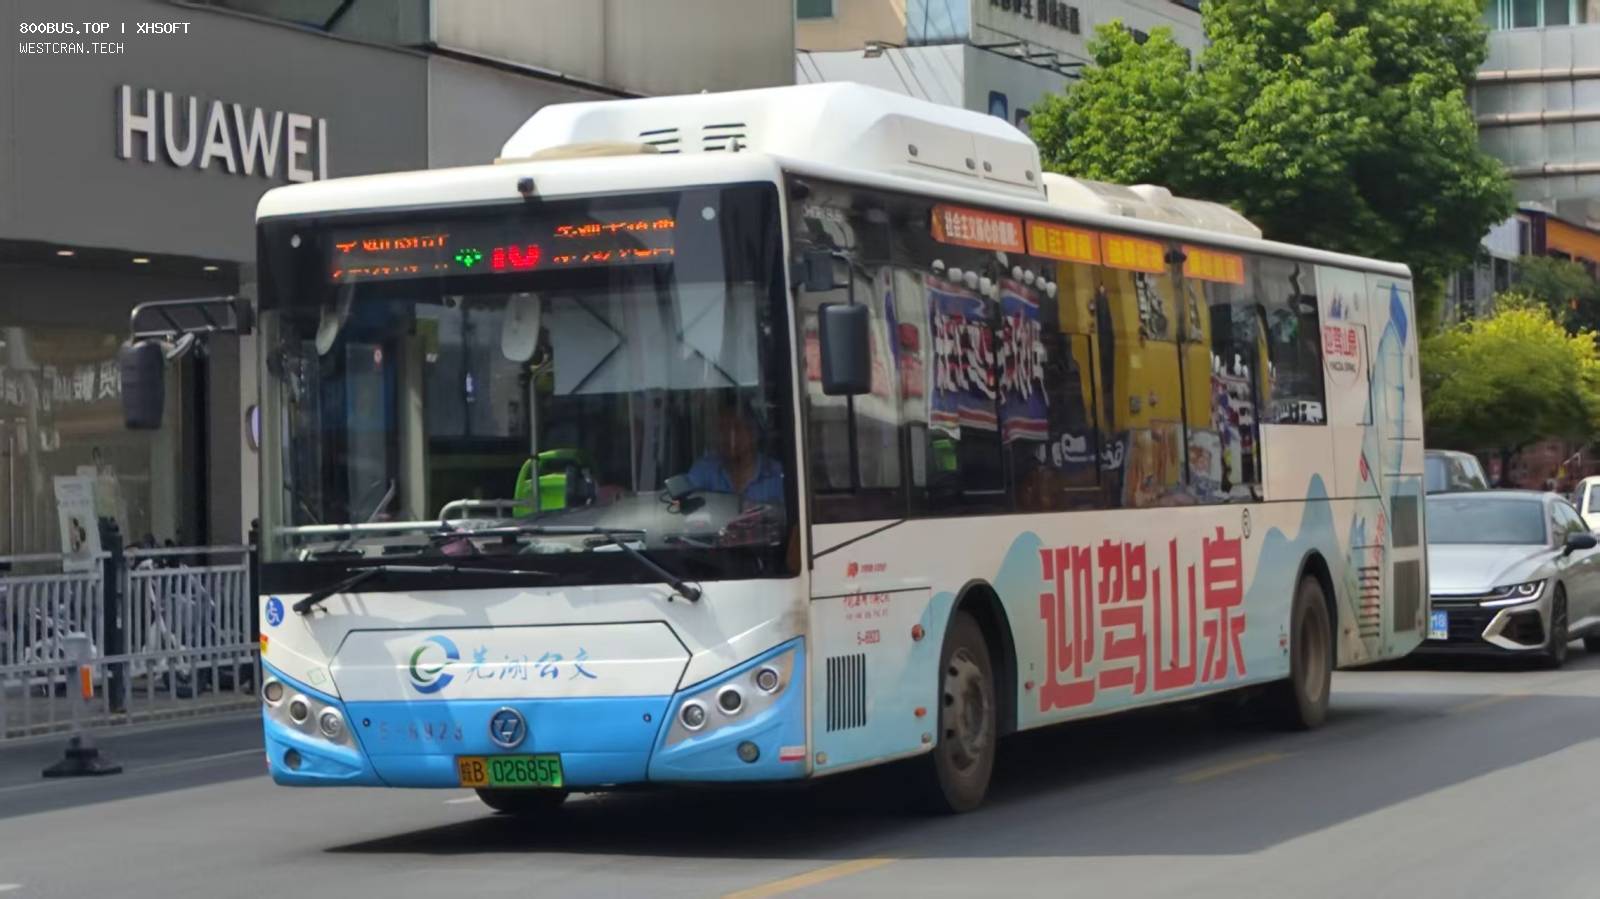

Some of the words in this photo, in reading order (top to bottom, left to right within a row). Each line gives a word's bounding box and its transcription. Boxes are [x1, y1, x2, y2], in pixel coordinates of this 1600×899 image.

[121, 84, 328, 183] HUAWEI
[1039, 526, 1247, 712] 迎驾山泉
[465, 643, 598, 683] 芜湖公交
[492, 760, 559, 782] 02685F
